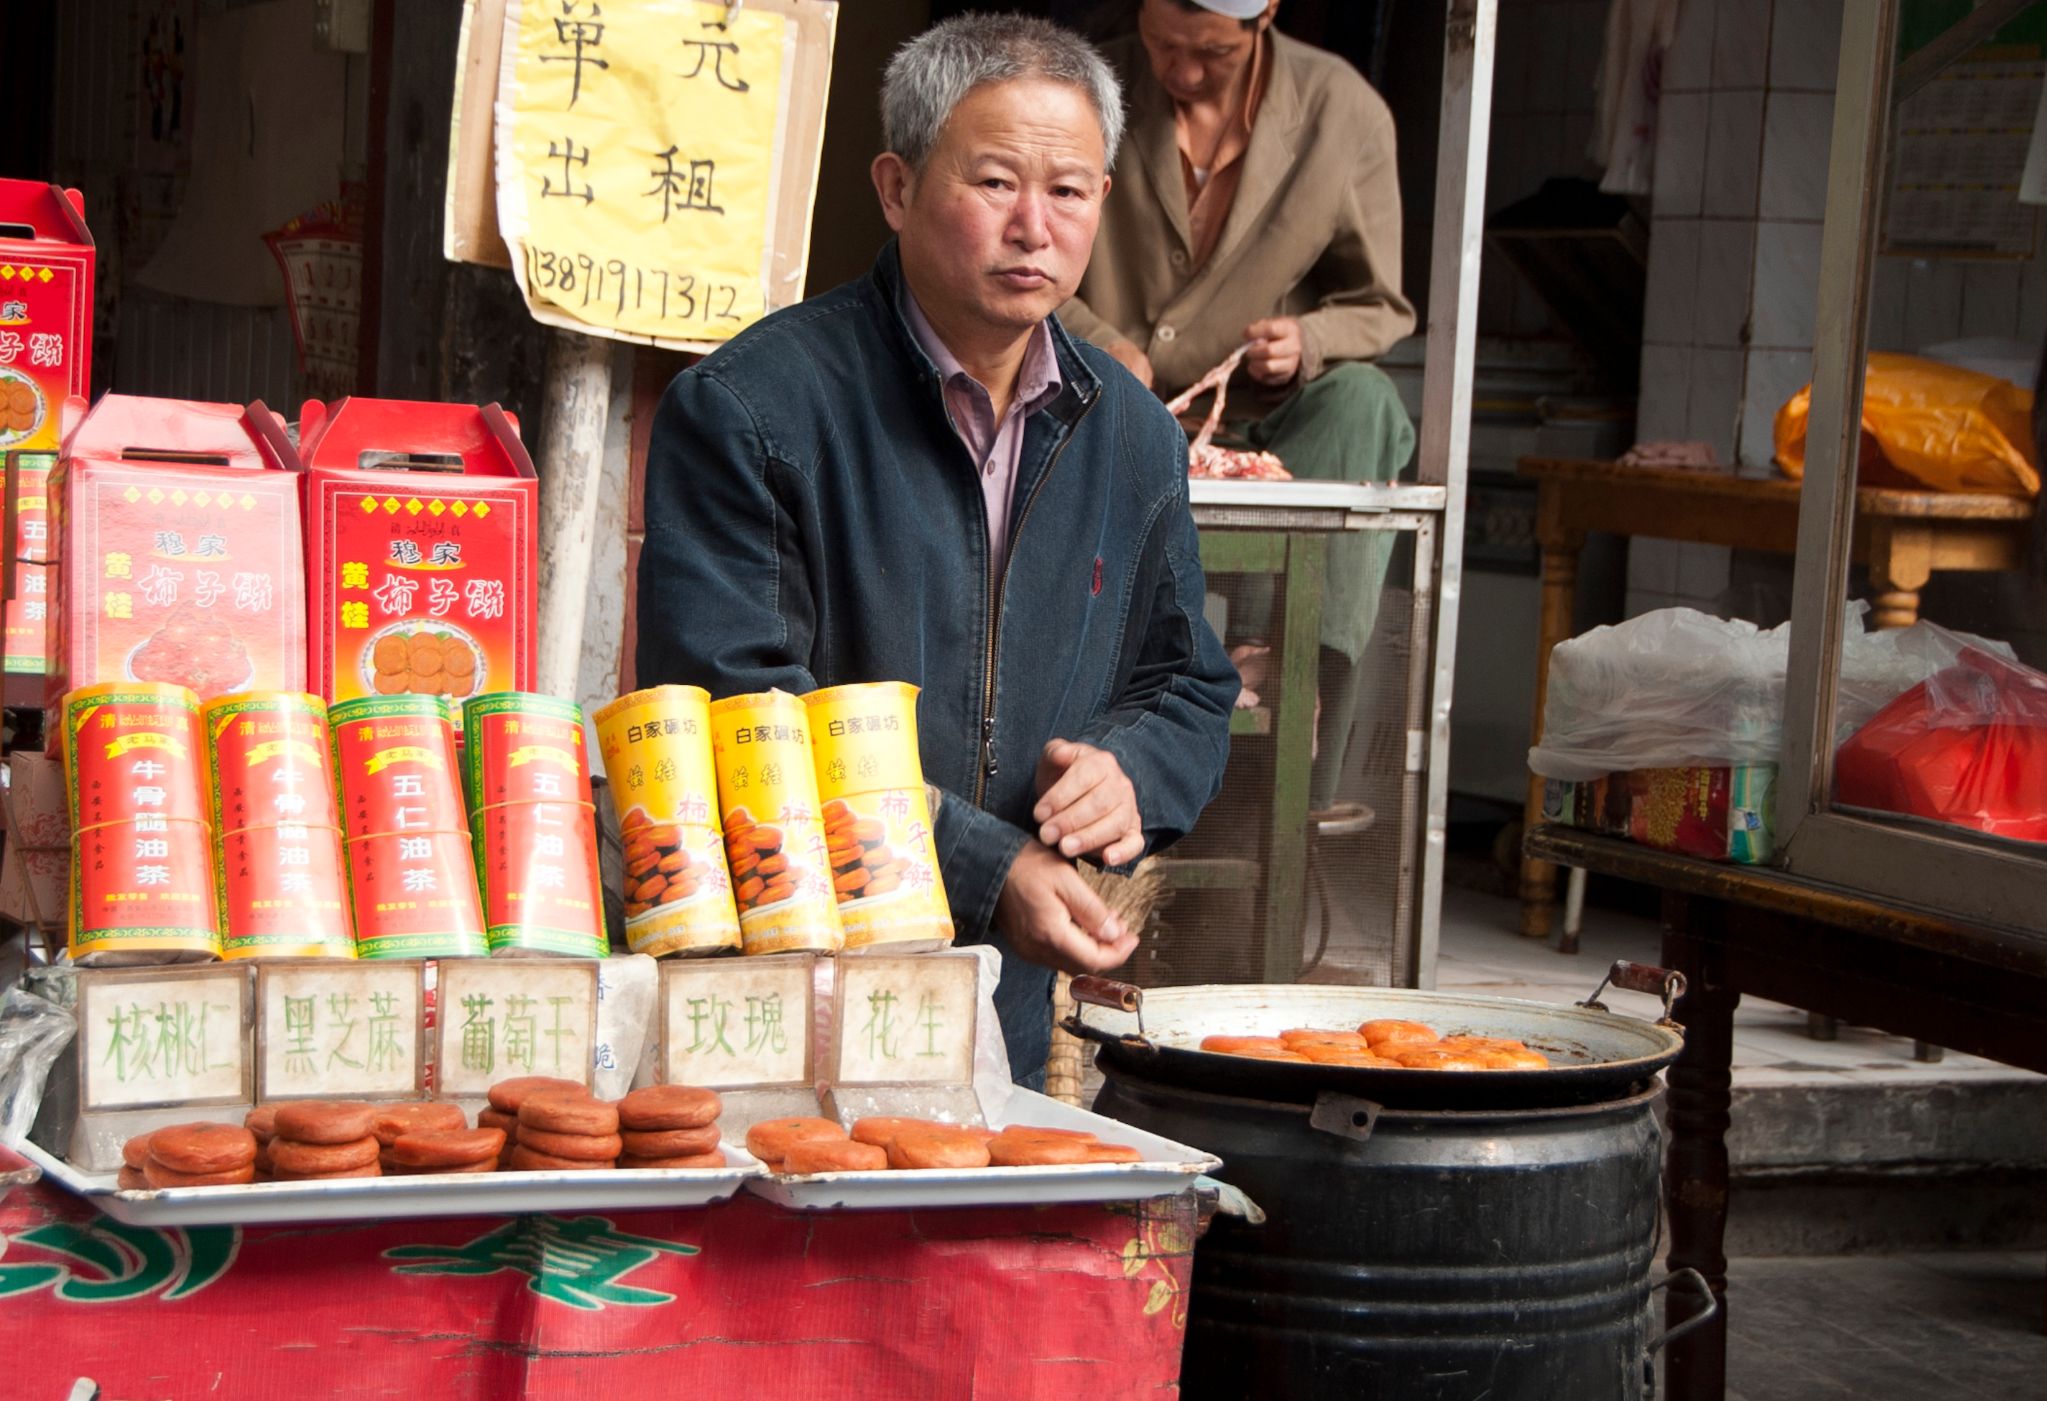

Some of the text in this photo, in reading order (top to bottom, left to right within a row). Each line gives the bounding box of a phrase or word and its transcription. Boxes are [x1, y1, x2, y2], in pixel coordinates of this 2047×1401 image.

[541, 137, 725, 223] 出租
[532, 244, 742, 322] 13891917312
[154, 530, 229, 557] 穆家
[390, 538, 463, 566] 穆家
[131, 759, 171, 886] 牛骨髓油茶
[392, 774, 437, 892] 五仁油茶
[102, 1000, 235, 1082] 核桃仁
[459, 991, 577, 1076] 葡萄干
[686, 991, 788, 1057] 玫瑰
[860, 988, 947, 1061] 花生
